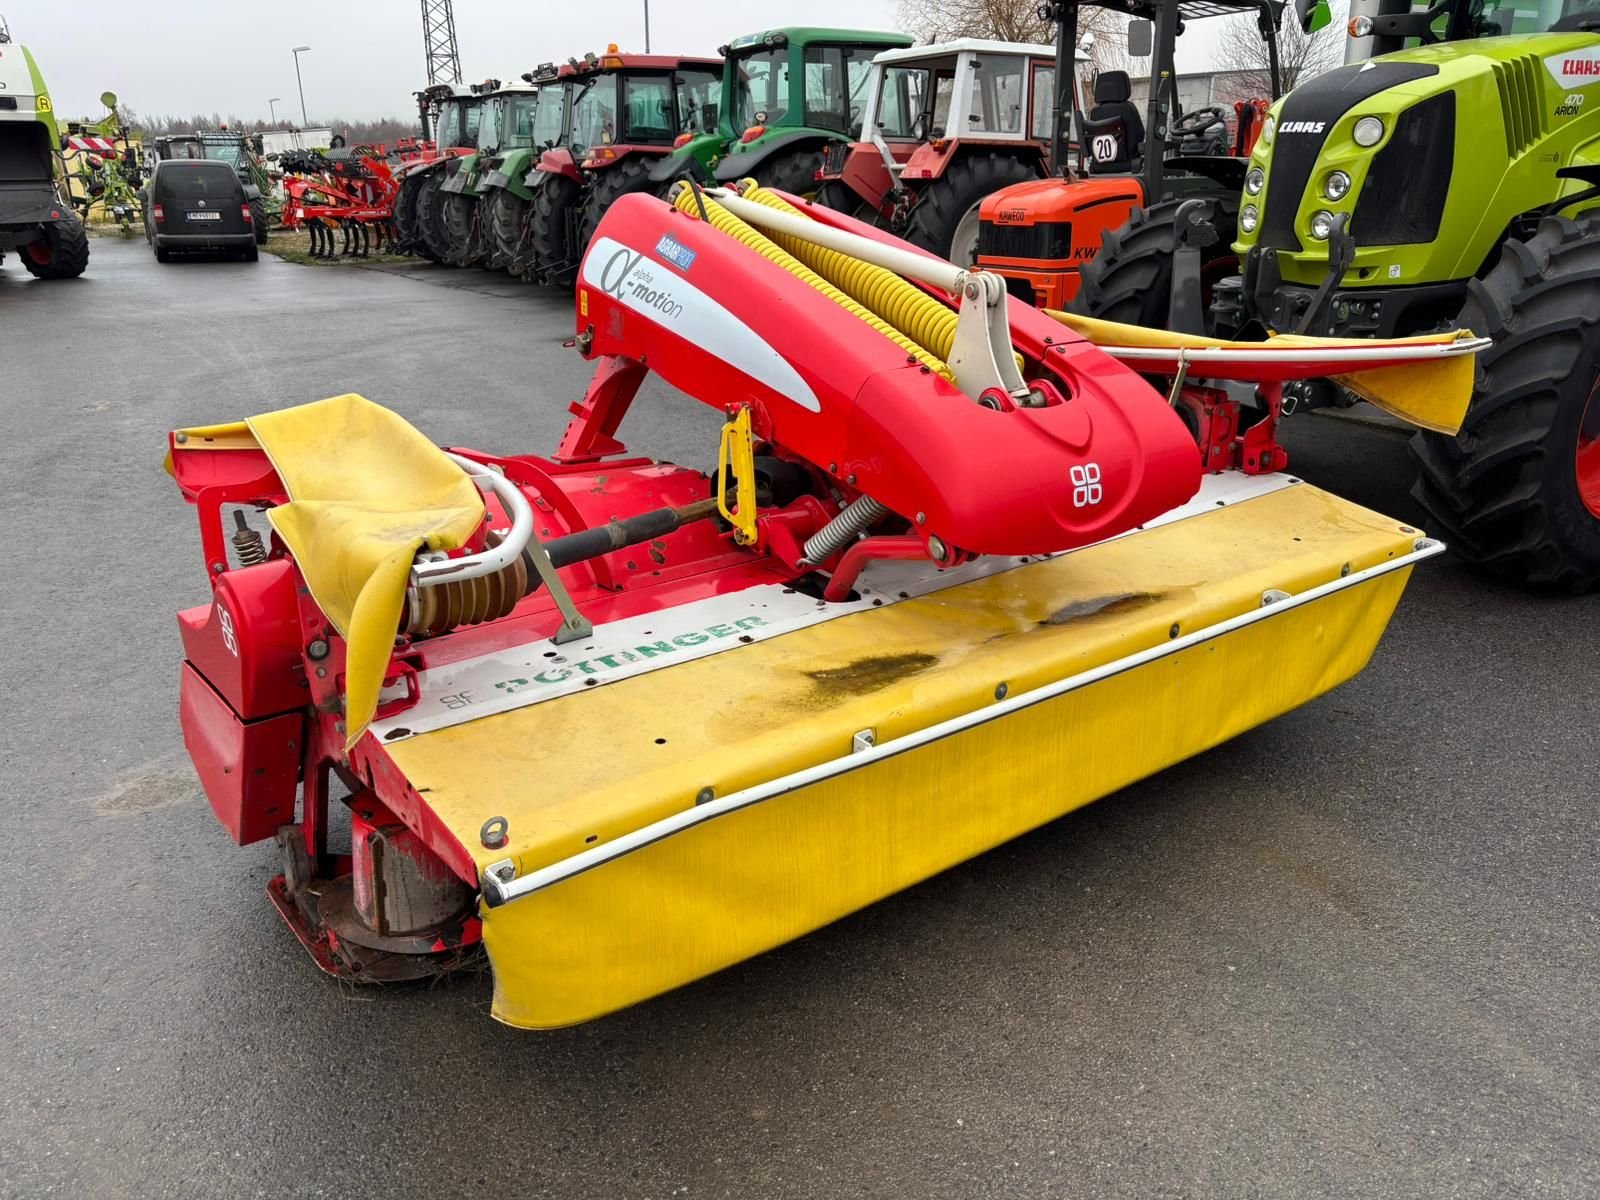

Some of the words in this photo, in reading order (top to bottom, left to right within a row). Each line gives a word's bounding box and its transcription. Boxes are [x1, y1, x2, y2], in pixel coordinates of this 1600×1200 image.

[1562, 60, 1600, 75] CLAAS
[40, 98, 50, 110] R
[1565, 95, 1584, 106] 470
[1554, 106, 1579, 116] ARION
[1279, 121, 1326, 133] CLAAS
[1096, 138, 1112, 160] 20
[633, 268, 654, 284] alpha
